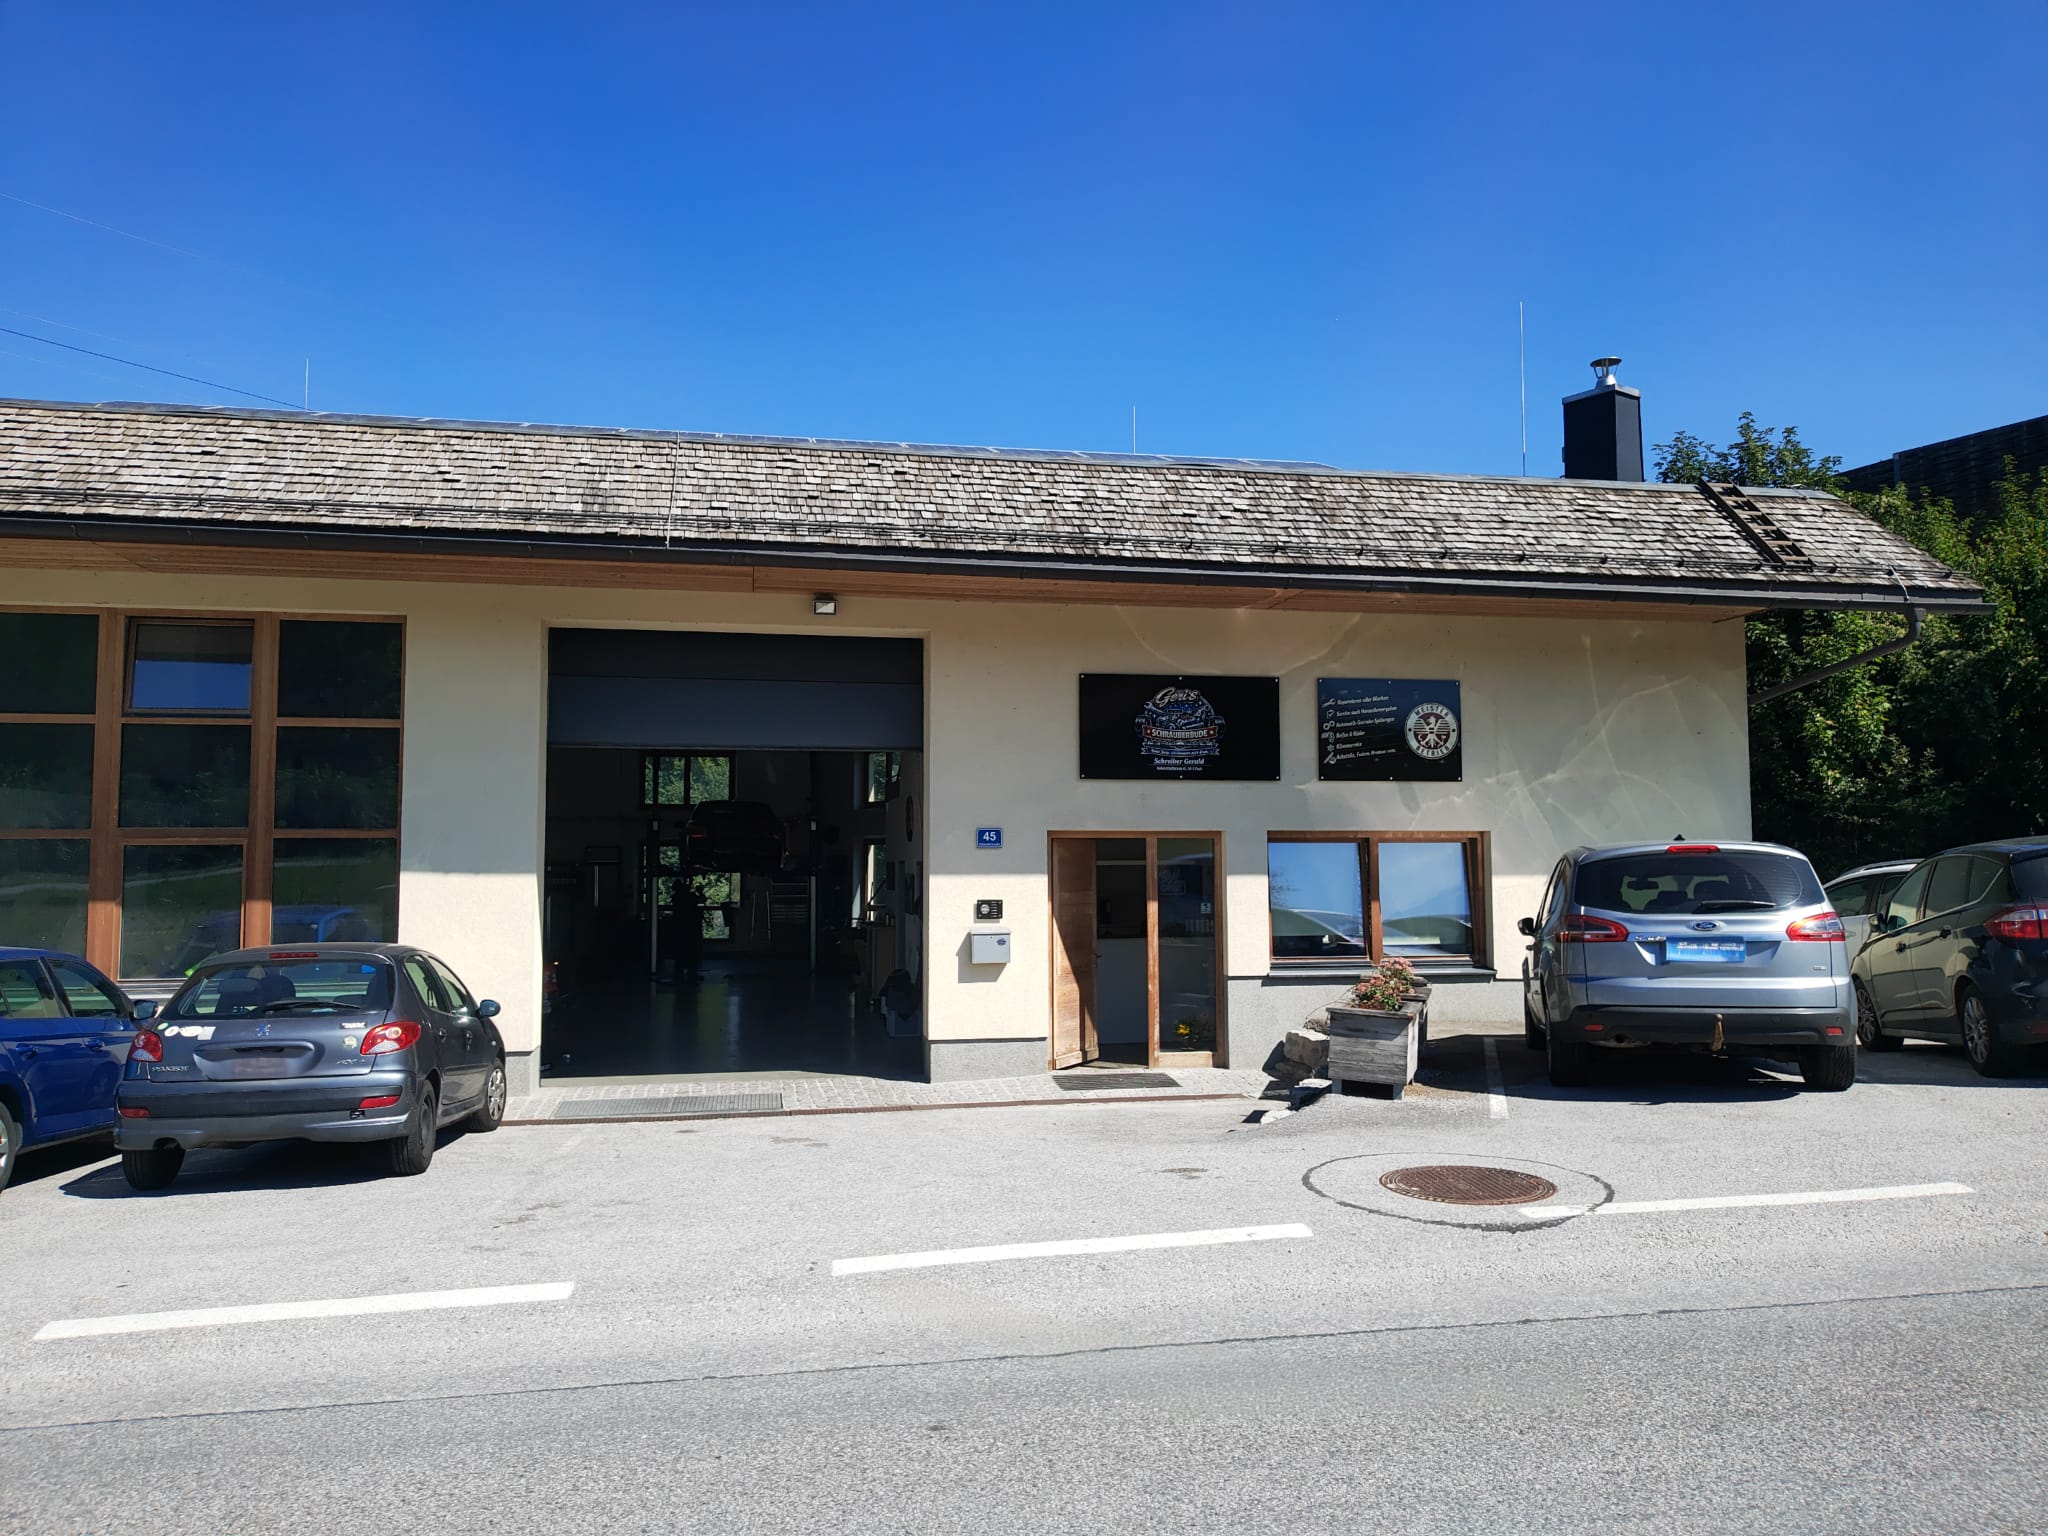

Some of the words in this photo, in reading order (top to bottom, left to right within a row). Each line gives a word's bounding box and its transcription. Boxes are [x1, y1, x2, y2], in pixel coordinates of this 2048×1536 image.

[1414, 705, 1450, 718] MEISTER
[1415, 745, 1450, 757] BETRIEB
[983, 831, 997, 841] 45
